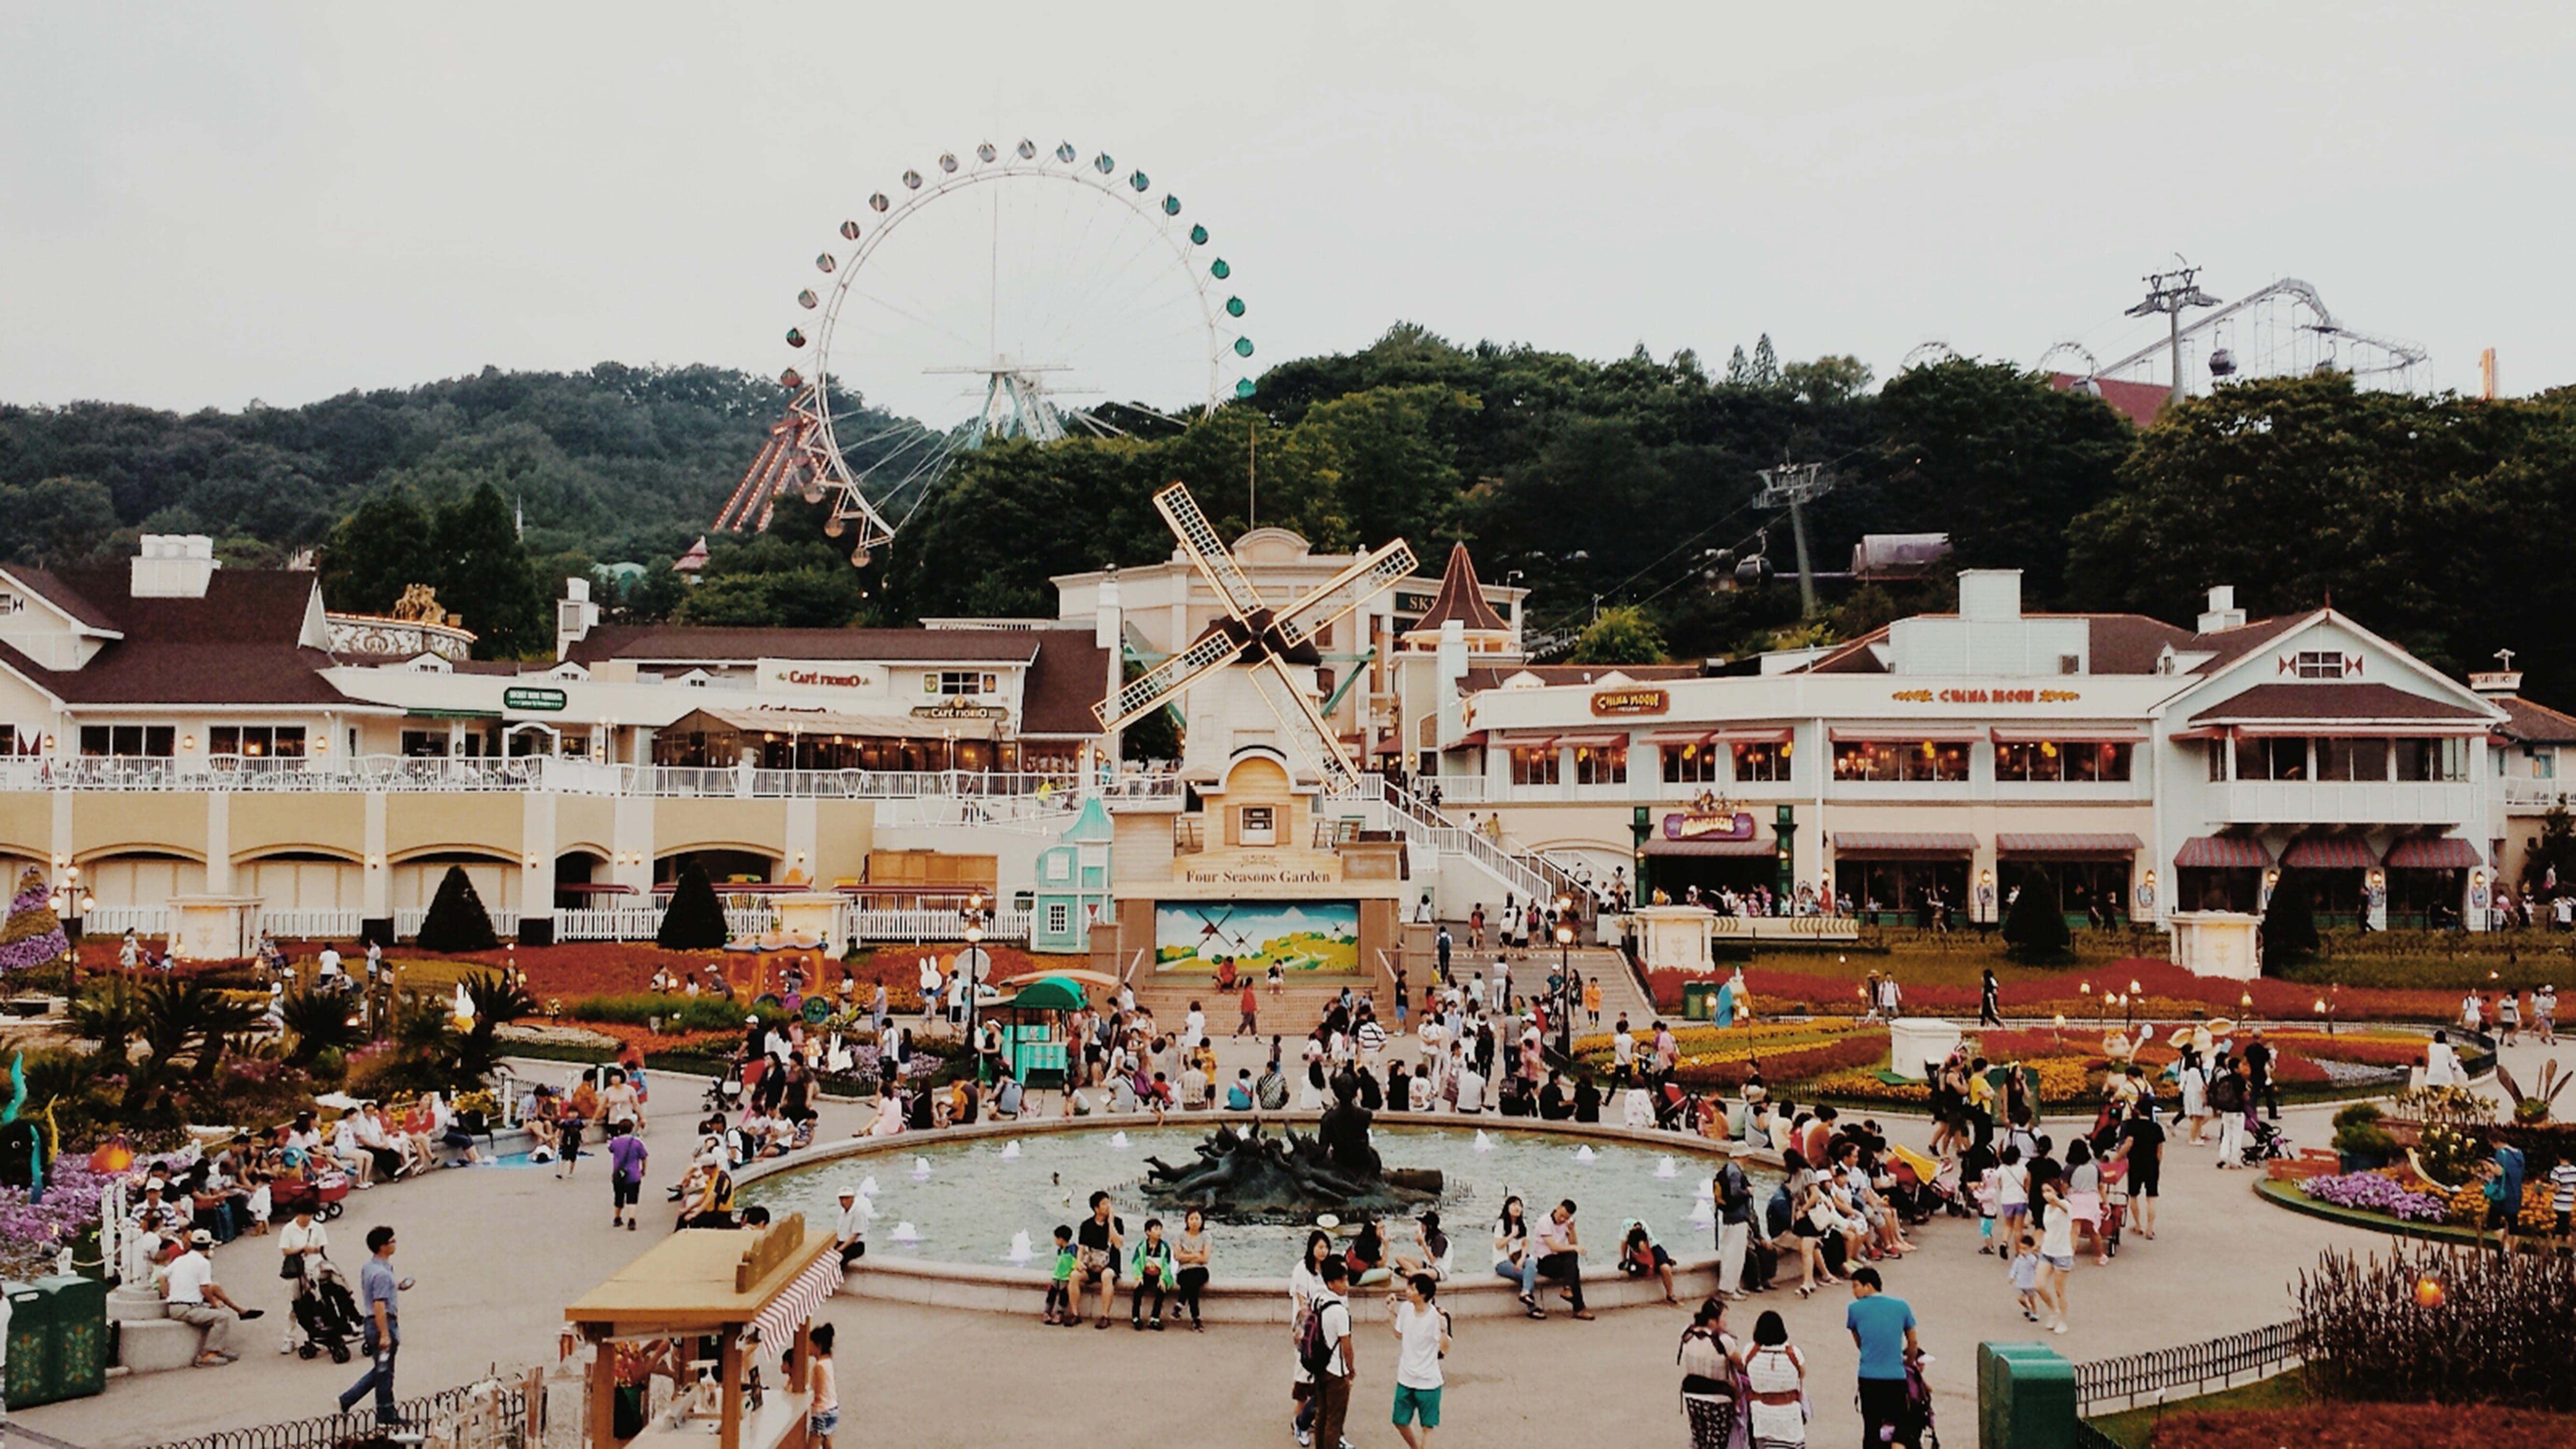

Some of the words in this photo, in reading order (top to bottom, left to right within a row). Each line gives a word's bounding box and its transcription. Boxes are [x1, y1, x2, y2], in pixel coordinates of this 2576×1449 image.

[1597, 695, 1628, 710] CHINA
[1630, 693, 1659, 707] MOON
[1939, 689, 1989, 703] CHINA
[1992, 689, 2035, 703] MOON
[1186, 870, 1218, 883] Four
[1223, 870, 1276, 883] Seasons
[1280, 870, 1331, 883] Garden
